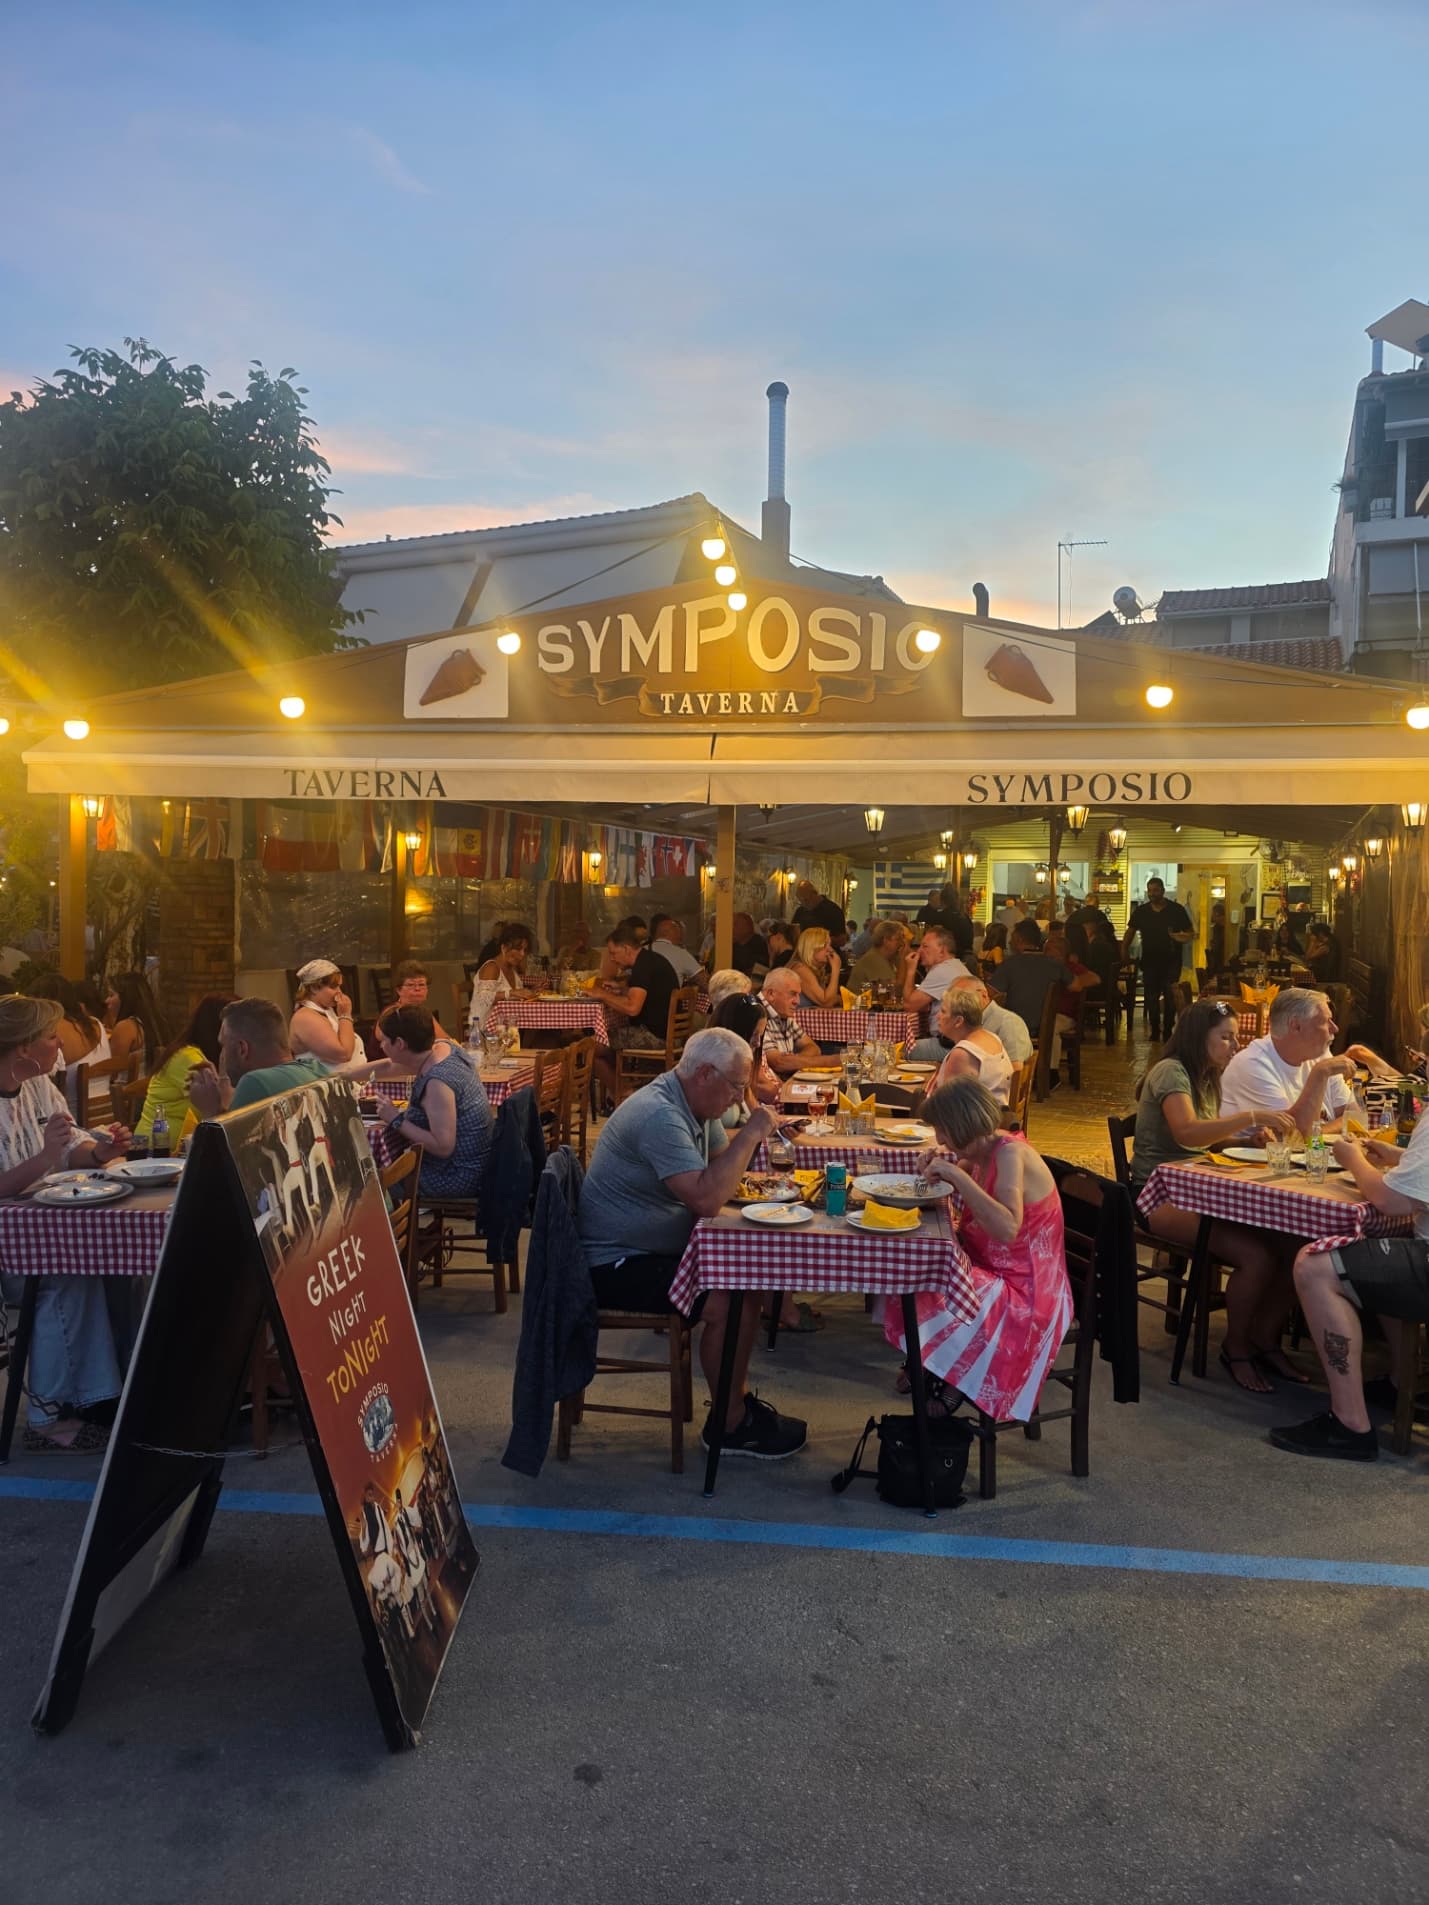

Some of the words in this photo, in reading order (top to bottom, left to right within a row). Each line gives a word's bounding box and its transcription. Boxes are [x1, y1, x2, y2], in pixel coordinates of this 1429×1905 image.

[538, 594, 936, 673] SYMPOSIO
[661, 691, 799, 714] TAVERNA
[284, 769, 447, 798] TAVERNA
[967, 772, 1192, 803] SYMPOSIO
[307, 1235, 365, 1306] GREEK
[328, 1291, 366, 1345] NIGHT
[326, 1315, 389, 1404] TONIGHT
[357, 1382, 389, 1429] SYMPOSIO
